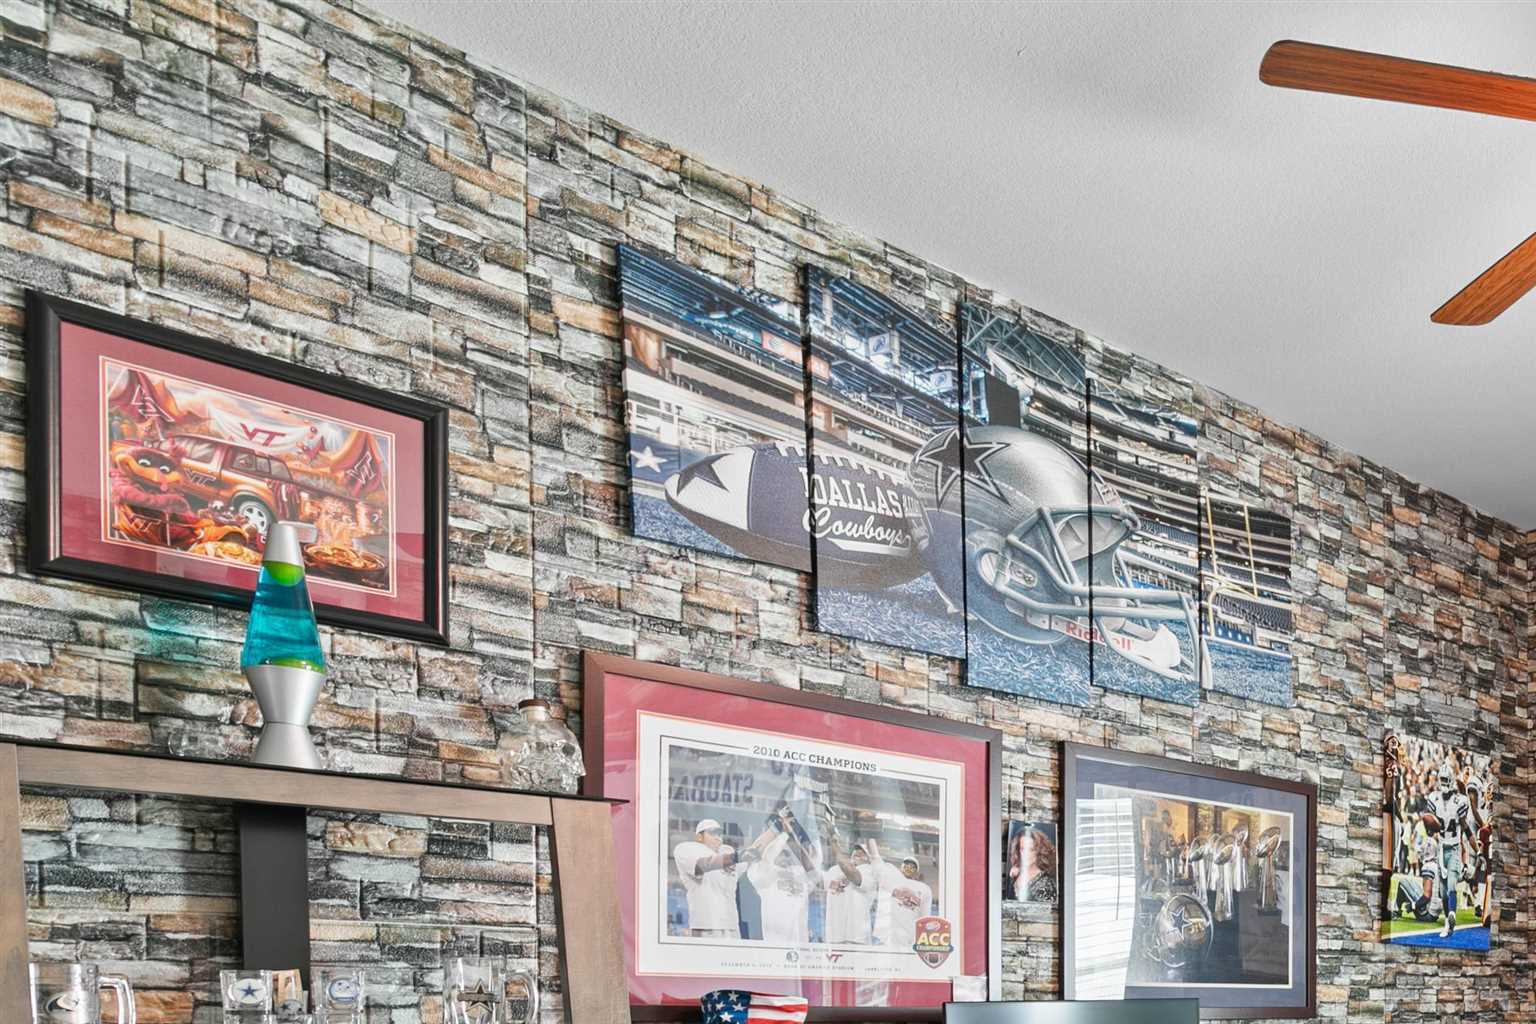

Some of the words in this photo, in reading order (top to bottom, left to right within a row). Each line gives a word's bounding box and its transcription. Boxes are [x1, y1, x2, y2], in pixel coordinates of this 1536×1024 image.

[240, 422, 285, 447] VT
[799, 465, 906, 520] DALLAS
[802, 504, 914, 548] Cowboys
[1065, 621, 1133, 651] Ridll
[753, 745, 780, 758] 2010
[783, 750, 807, 761] ACC
[808, 753, 877, 773] CHAMPIONS
[917, 932, 950, 946] ACC
[826, 953, 844, 963] VT
